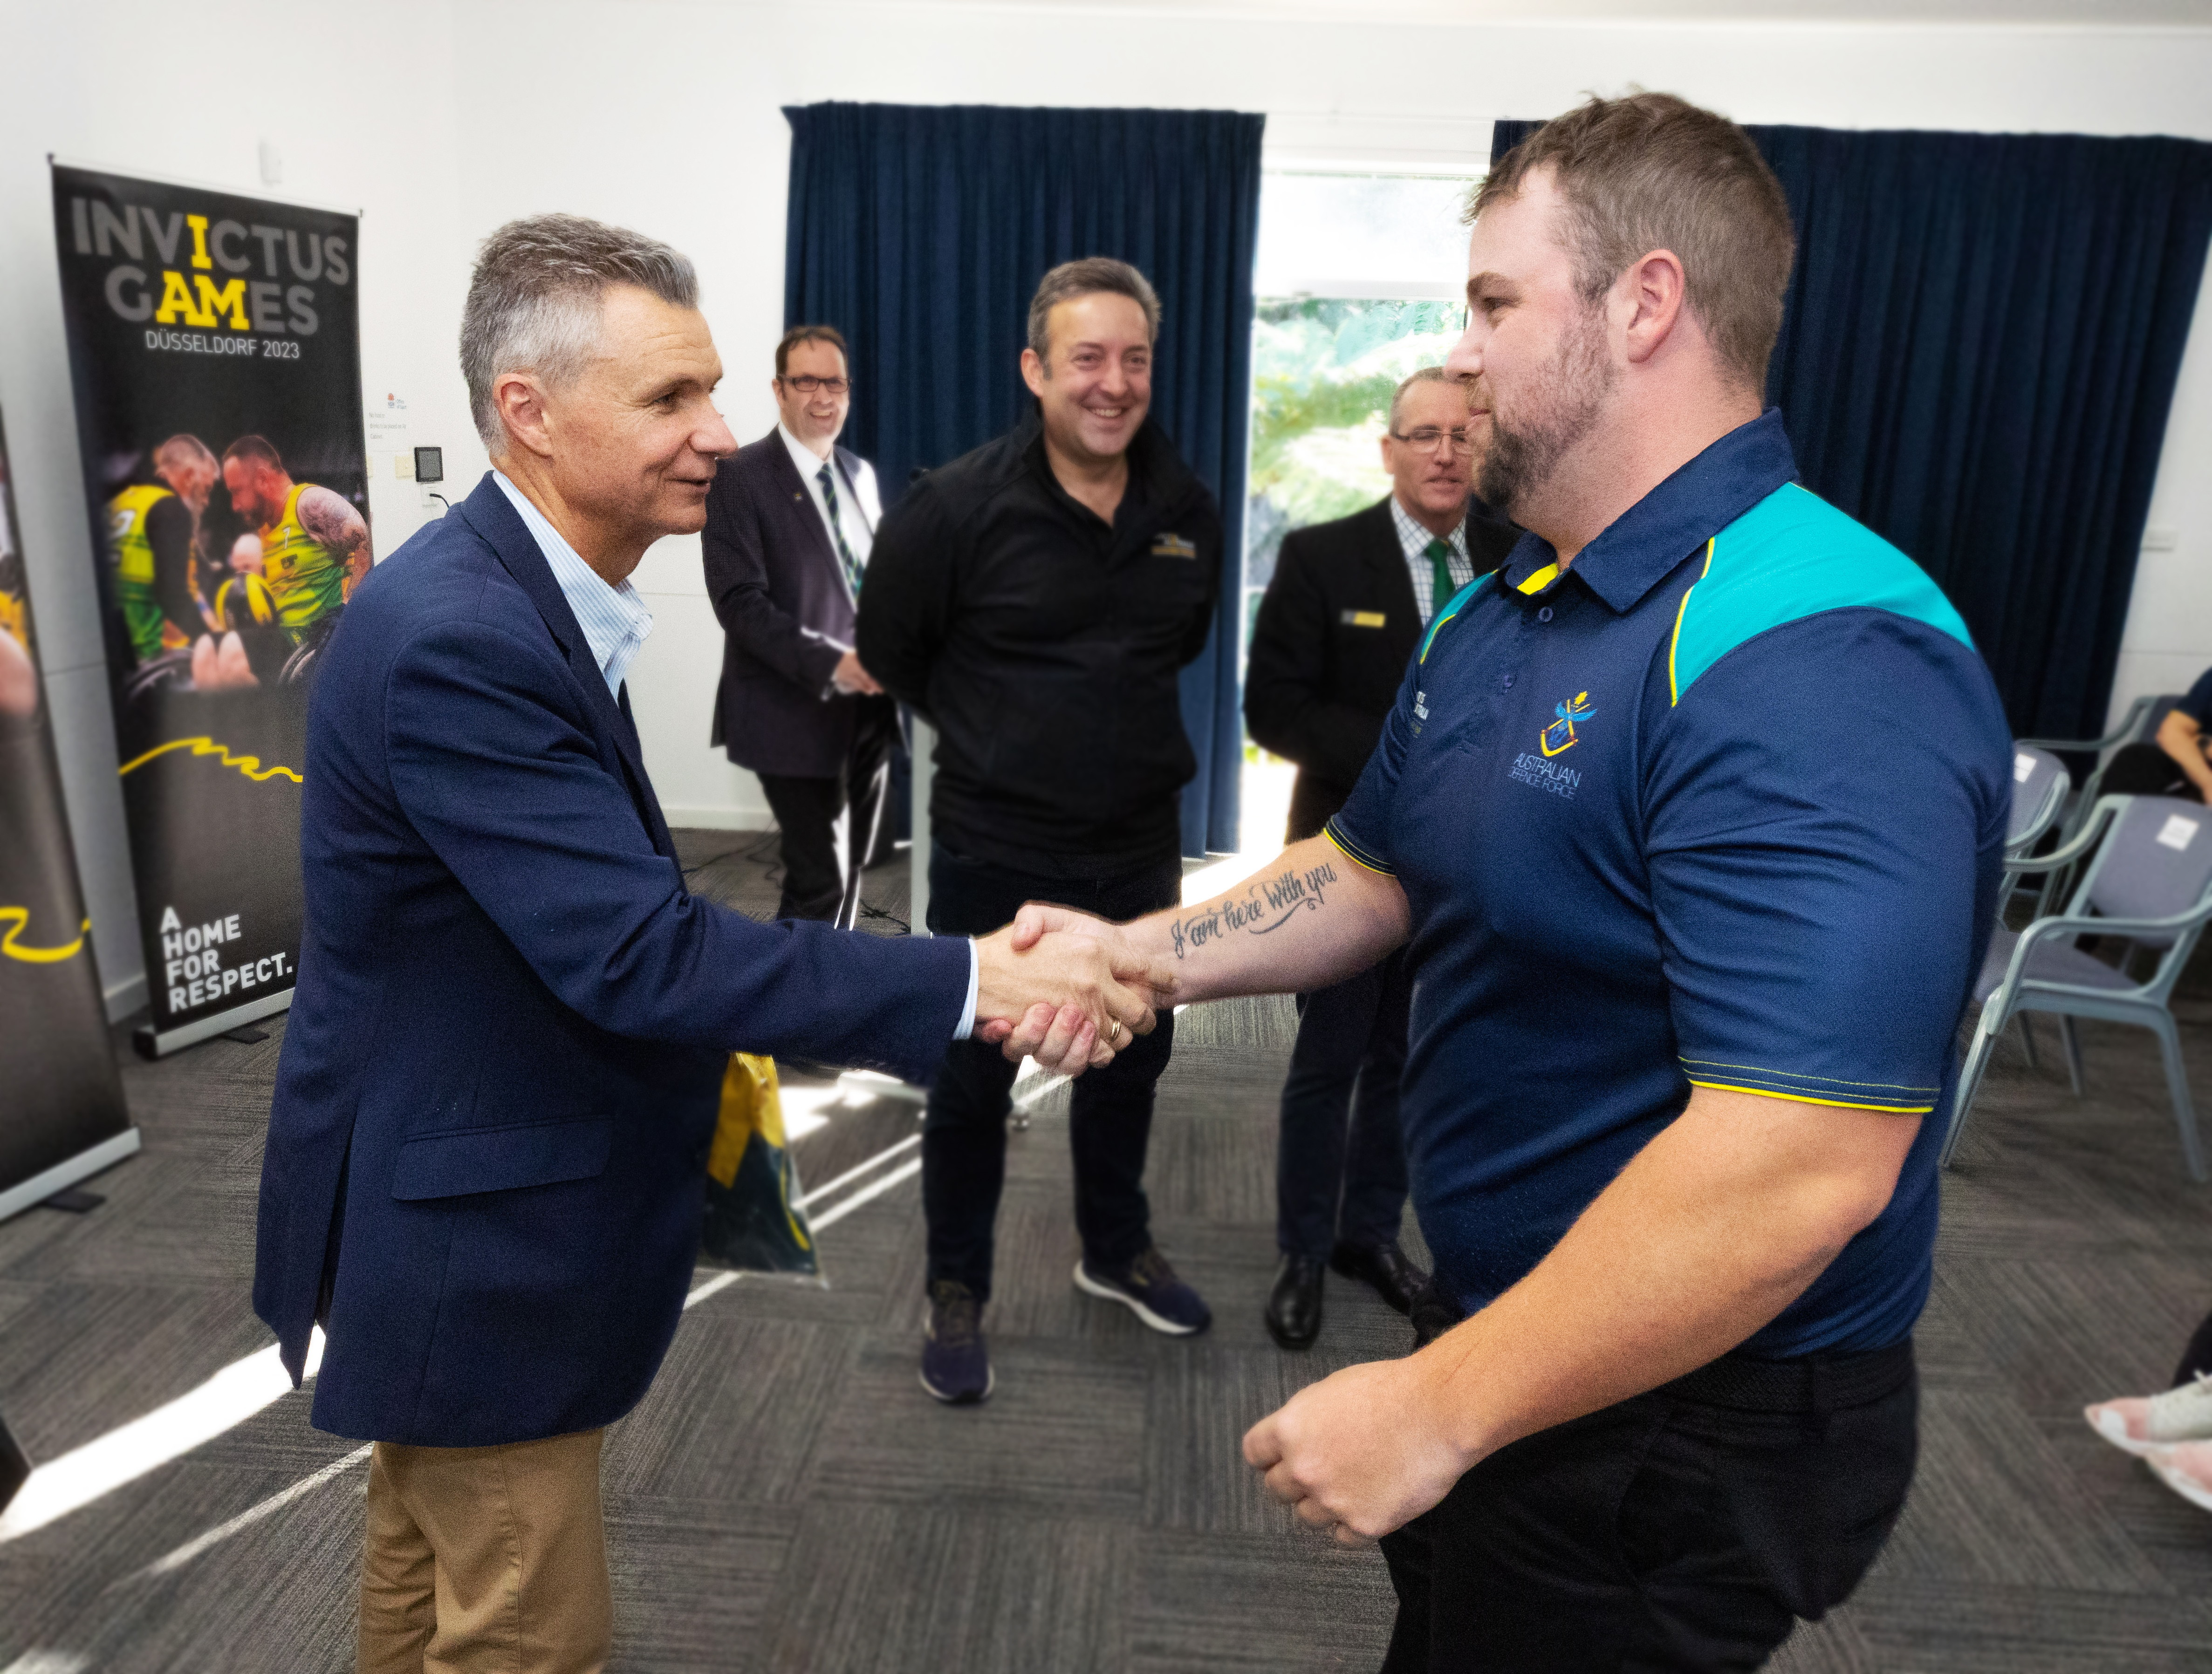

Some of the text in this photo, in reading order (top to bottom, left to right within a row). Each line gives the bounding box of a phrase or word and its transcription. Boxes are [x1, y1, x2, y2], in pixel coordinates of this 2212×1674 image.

[72, 197, 349, 285] INVICTUS
[104, 265, 319, 335] GAMES
[145, 328, 300, 360] DÜSSELDORF 2023
[1513, 752, 1582, 787] AUSTRALIAN
[1542, 778, 1575, 800] FORCE
[1223, 900, 1265, 931] here
[1305, 862, 1337, 905] you
[160, 907, 181, 933] A
[163, 914, 241, 960] HOME
[166, 949, 221, 987] FOR
[169, 952, 293, 1013] RESPECT.
